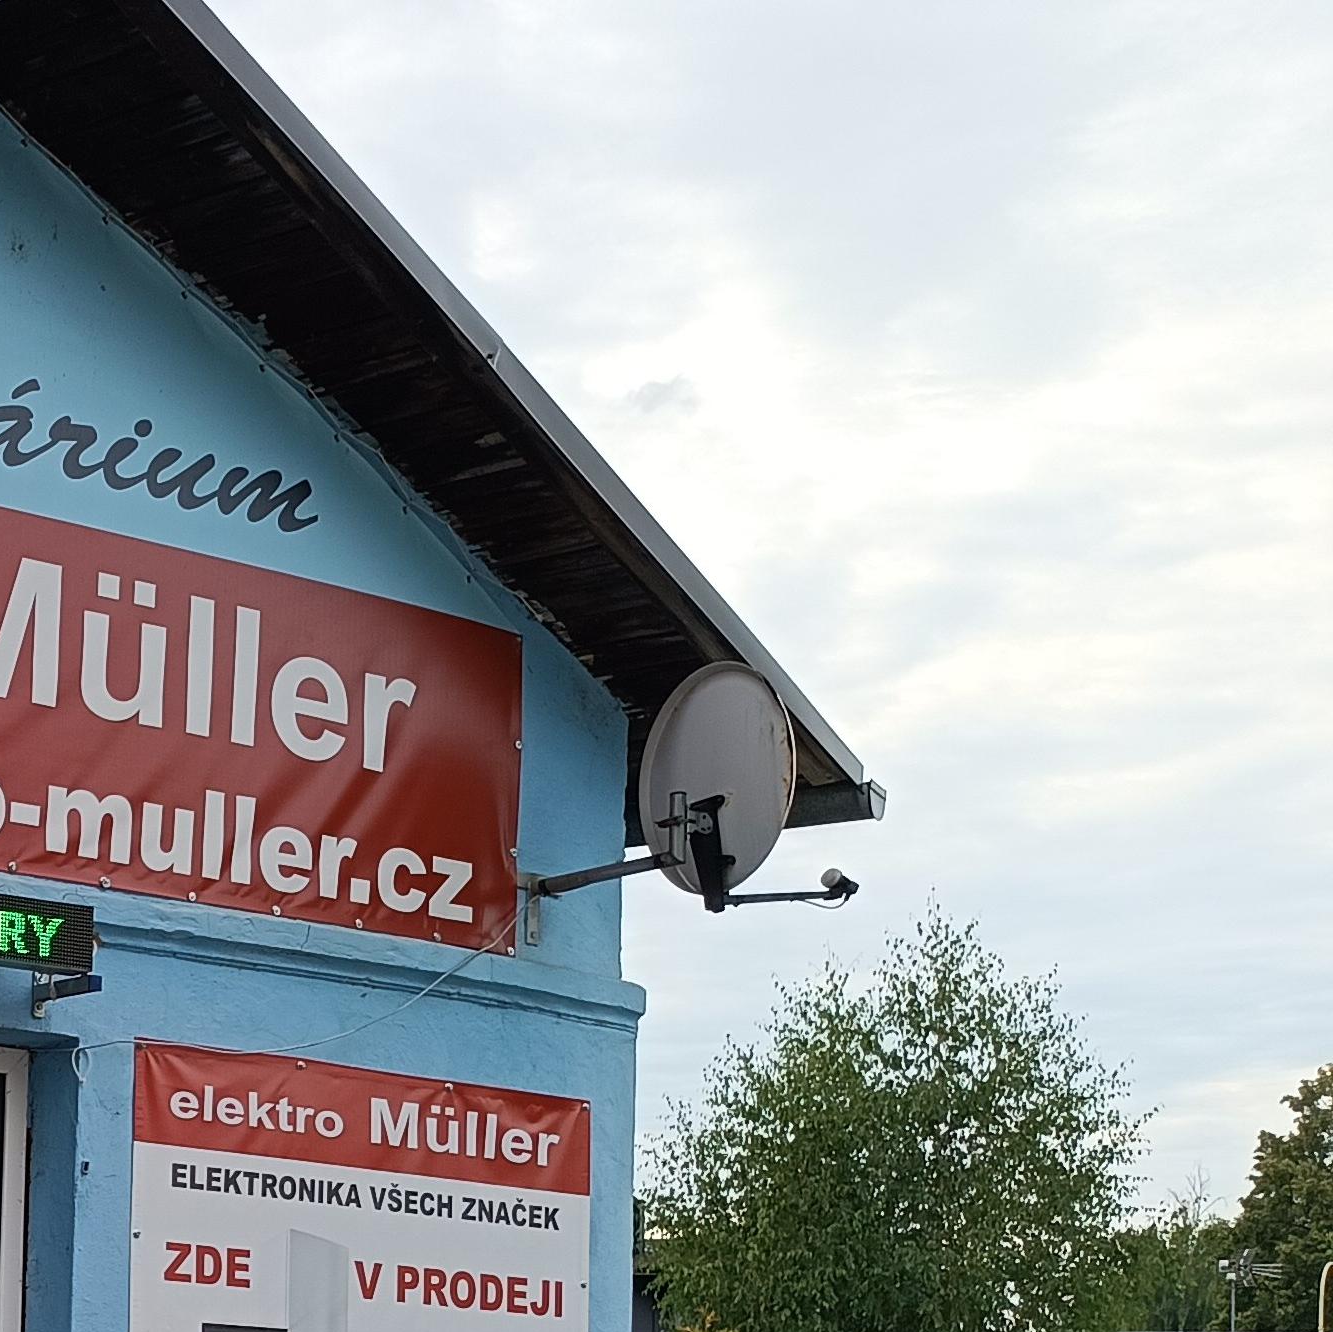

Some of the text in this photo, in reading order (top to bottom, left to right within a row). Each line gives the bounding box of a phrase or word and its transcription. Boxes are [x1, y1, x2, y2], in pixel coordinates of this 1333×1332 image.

[169, 1084, 561, 1168] elektro Müller
[171, 1163, 561, 1231] ELEKTRONIKA VŠECH ZNAČEK
[163, 1241, 565, 1318] ZDE V PRODEJI
